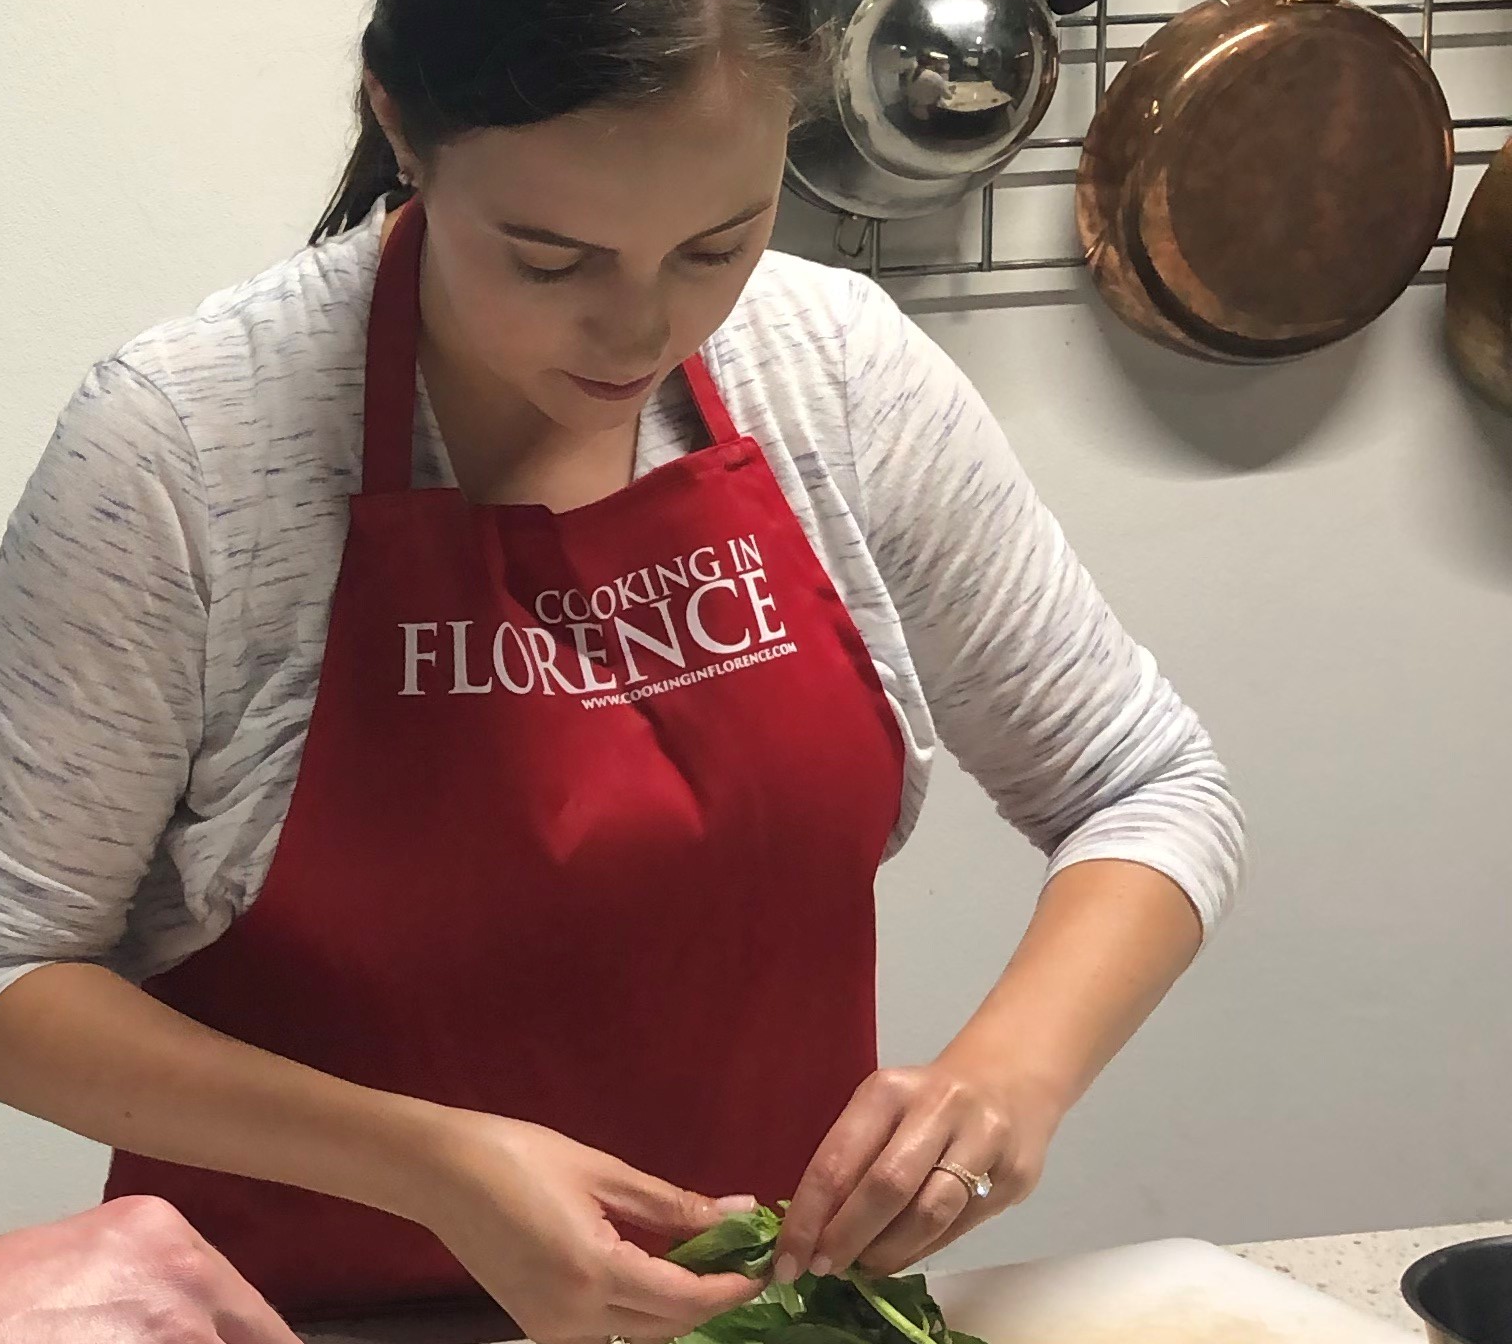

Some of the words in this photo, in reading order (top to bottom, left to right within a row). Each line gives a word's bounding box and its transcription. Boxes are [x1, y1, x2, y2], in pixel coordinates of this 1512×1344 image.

[535, 546, 721, 625] COOKING
[727, 534, 765, 573] IN
[397, 570, 787, 697] FLORENCE
[581, 641, 798, 710] WWW.COOKINGINFLORENCE.COM
